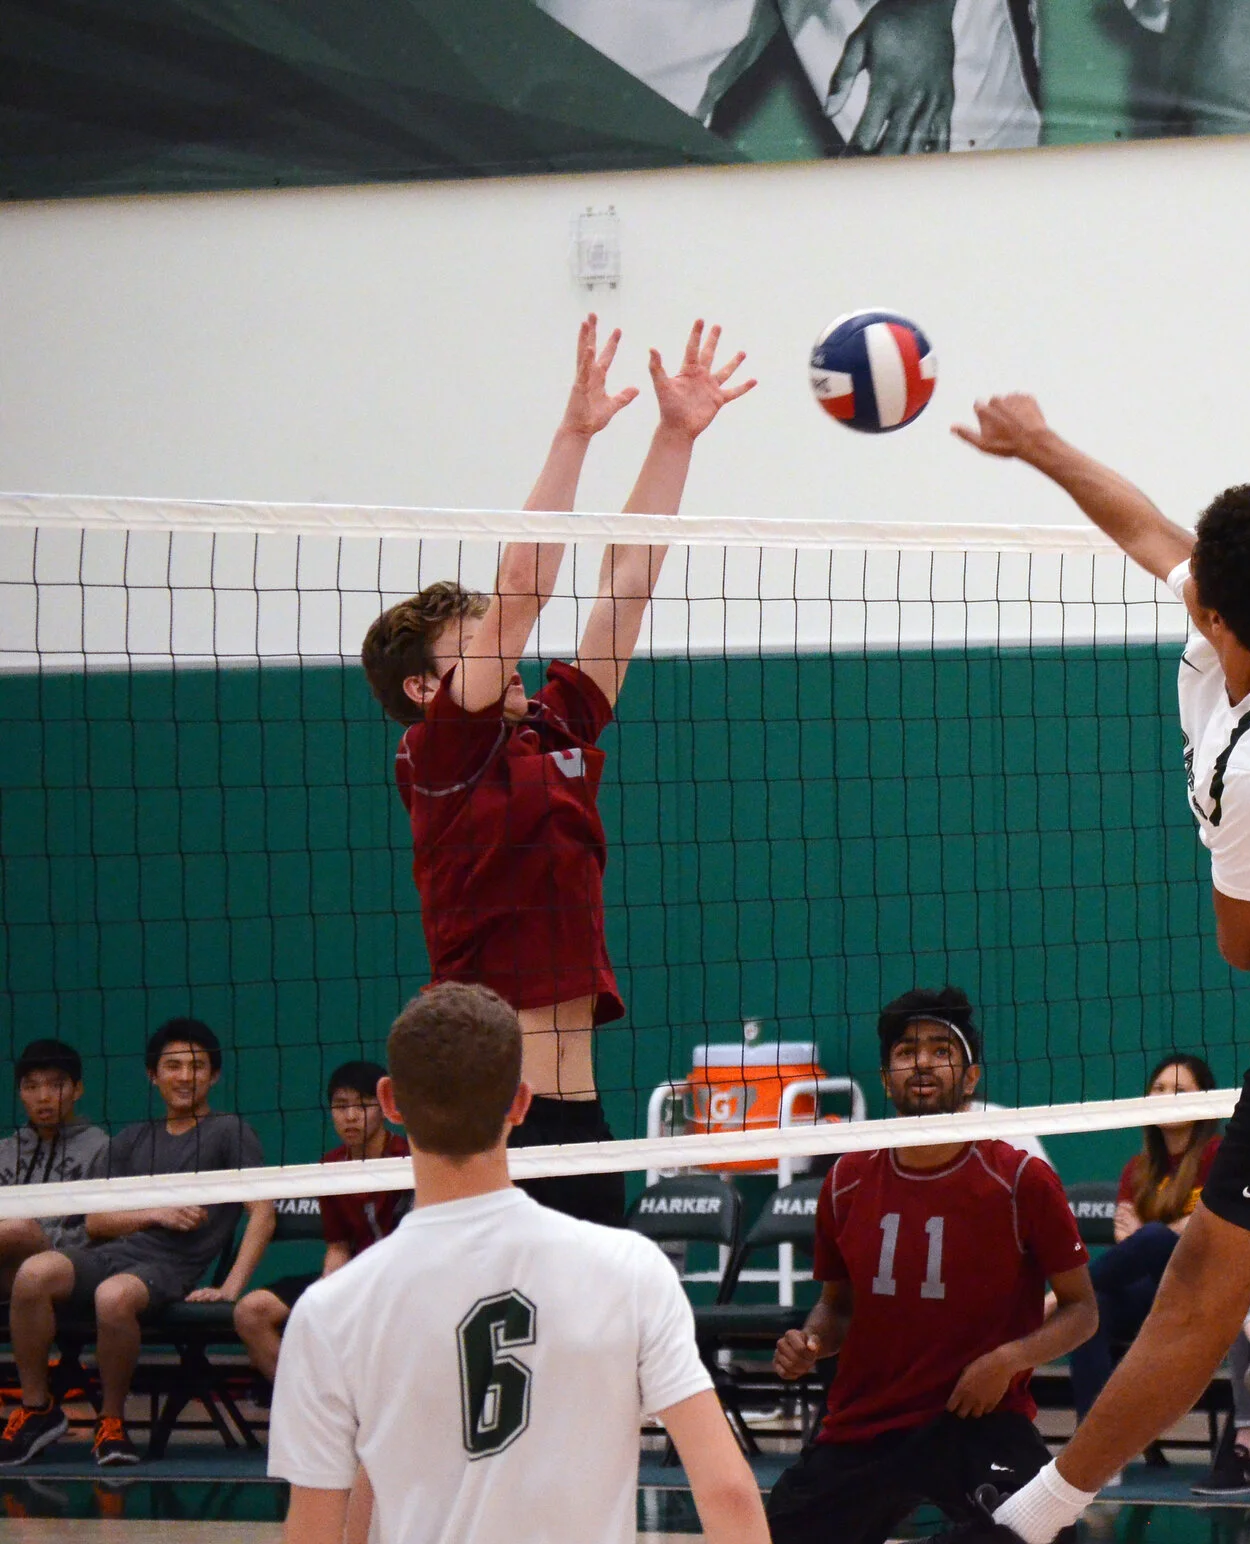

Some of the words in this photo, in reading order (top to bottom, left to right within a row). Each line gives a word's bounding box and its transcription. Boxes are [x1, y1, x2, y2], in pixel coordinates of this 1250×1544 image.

[639, 1196, 722, 1214] HARKER
[871, 1212, 946, 1300] 11
[455, 1288, 537, 1462] 6
